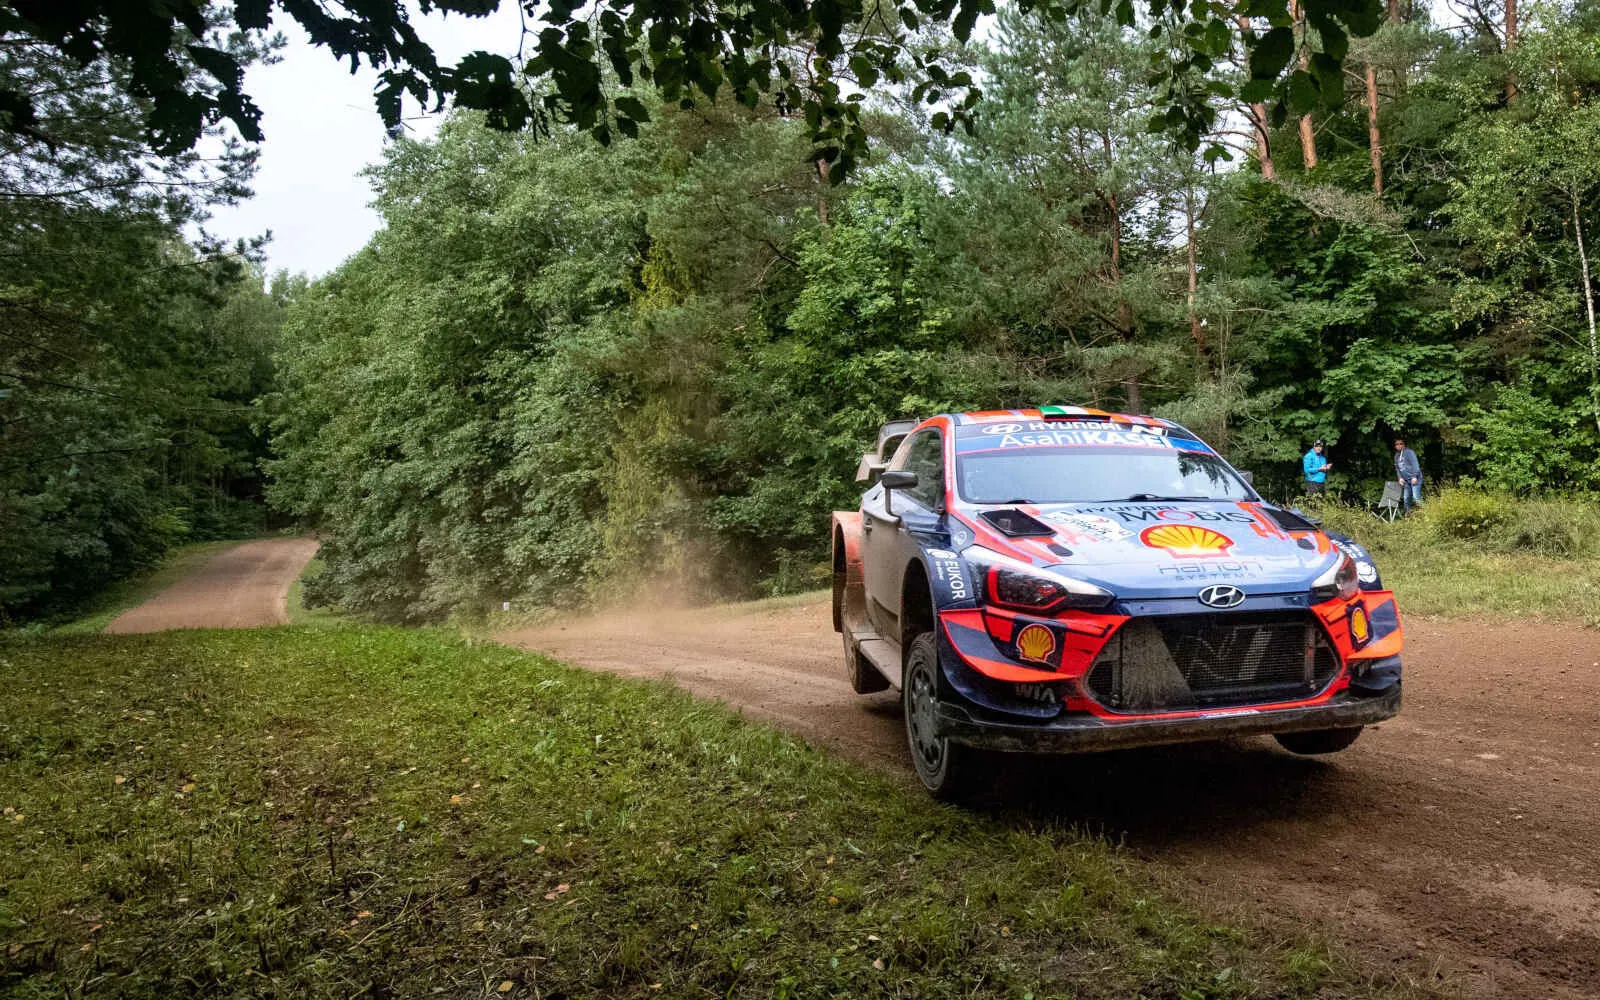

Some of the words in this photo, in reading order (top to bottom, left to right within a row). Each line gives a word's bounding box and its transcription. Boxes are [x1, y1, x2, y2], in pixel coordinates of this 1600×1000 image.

[1029, 421, 1123, 431] HYUNDAI
[1116, 510, 1257, 523] MOBIS
[944, 560, 966, 600] EUKOR
